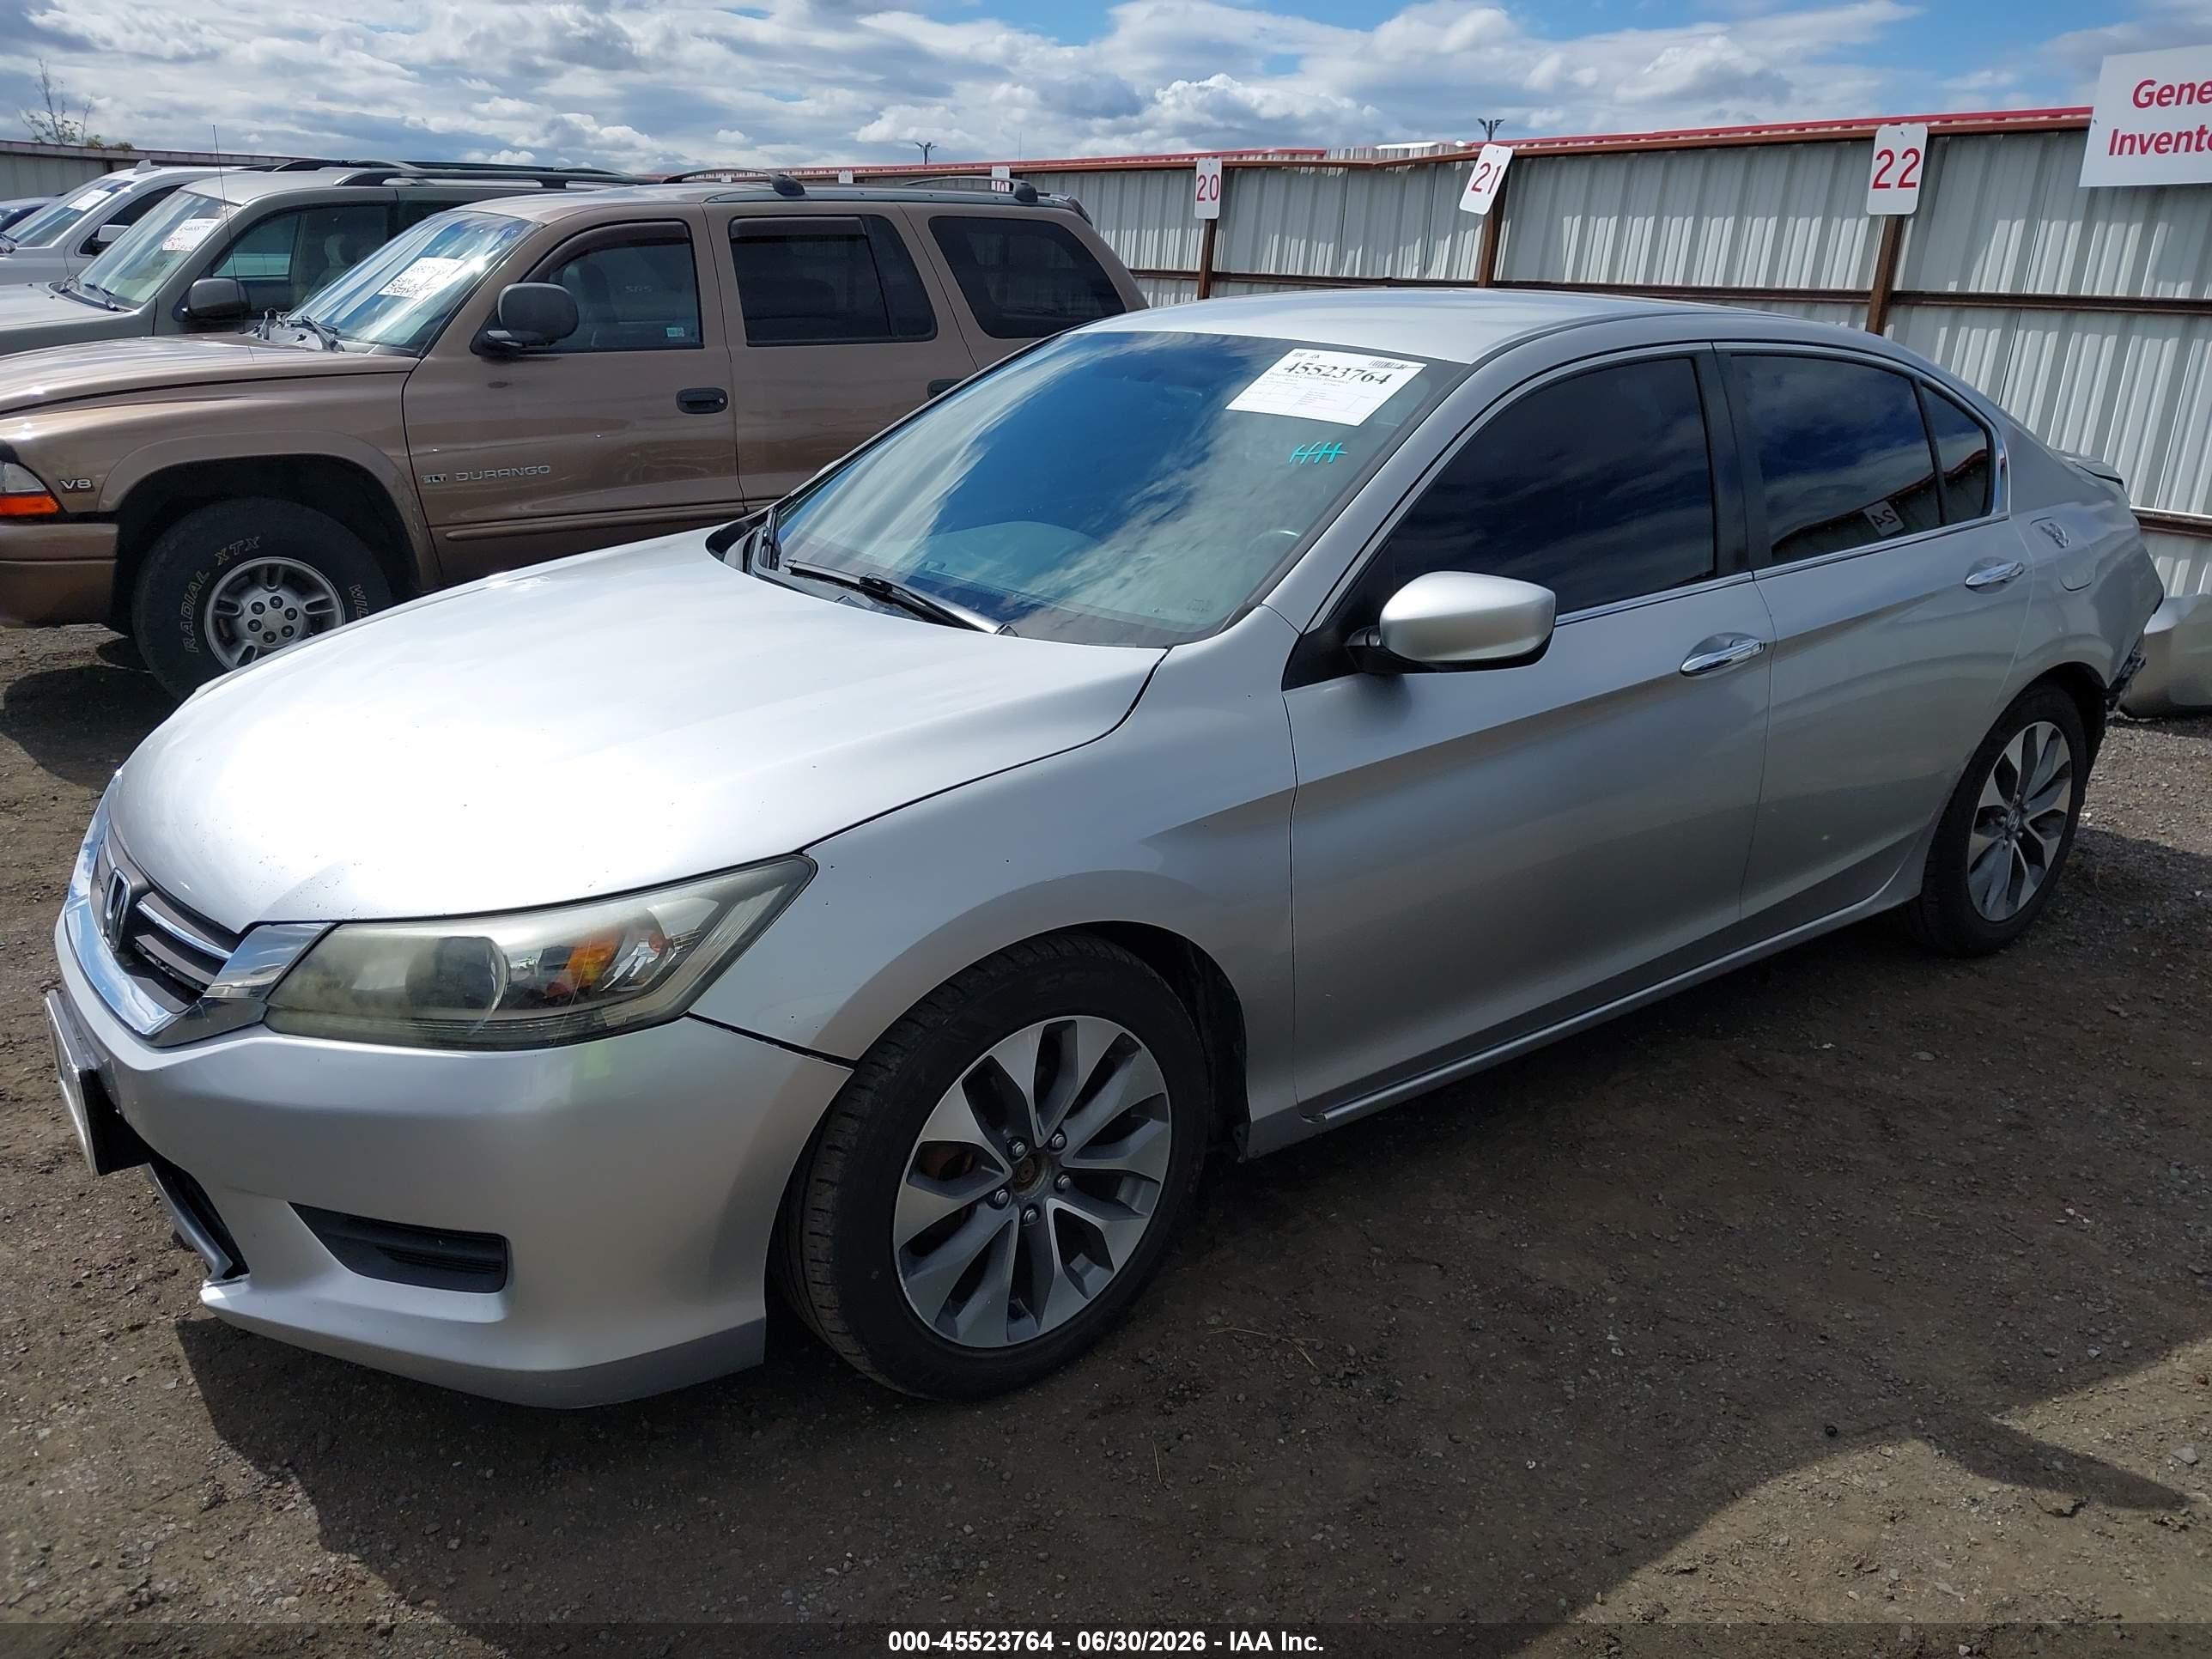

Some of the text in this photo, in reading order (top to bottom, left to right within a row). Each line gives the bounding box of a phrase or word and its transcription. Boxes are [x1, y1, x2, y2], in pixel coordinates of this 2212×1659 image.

[2132, 79, 2212, 109] Gene
[2108, 125, 2212, 156] Invent
[1471, 161, 1503, 195] 21
[1873, 148, 1921, 189] 22
[1196, 173, 1220, 202] 20
[1285, 362, 1392, 385] 45523764
[60, 478, 92, 489] V8
[456, 465, 550, 482] DURANGO
[180, 536, 260, 653] RADIAL XTX
